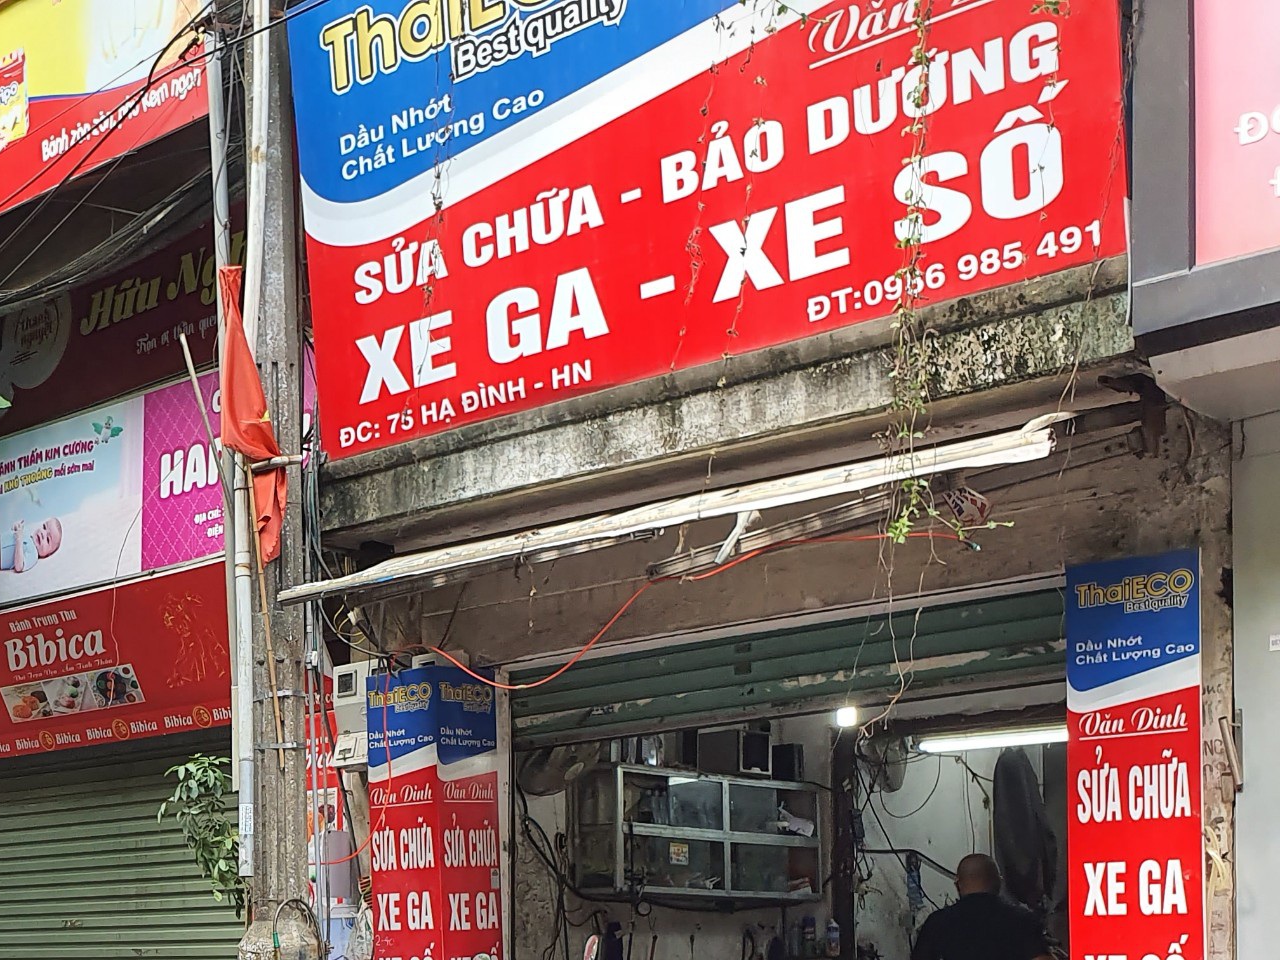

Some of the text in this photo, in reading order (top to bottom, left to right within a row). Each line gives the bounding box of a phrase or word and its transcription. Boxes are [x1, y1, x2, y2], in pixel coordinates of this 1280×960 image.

[454, 35, 519, 77] Best
[141, 82, 169, 113] kem
[170, 68, 202, 100] ngon
[338, 93, 452, 157] Dầu Nhớt
[341, 89, 546, 182] Chất Lượng Cao
[354, 22, 1060, 305] SỬA CHỮA BẢO DƯỠNG
[355, 79, 1070, 405] XE GA XE SỐ
[957, 241, 1023, 281] 985
[1036, 219, 1101, 258] 491
[339, 359, 593, 448] ĐC: 75 HẠ ĐÌNH HN
[45, 446, 61, 461] KIM
[1075, 568, 1194, 608] ThaiECO
[1125, 594, 1188, 613] Best quality
[32, 613, 59, 628] Trung
[59, 609, 77, 622] Thu
[4, 628, 107, 672] Bibica
[1075, 643, 1195, 665] Chất Lượng Cao
[1076, 635, 1143, 653] Dầu Nhớt
[368, 682, 433, 708] ThaiECO
[15, 737, 40, 750] Bibica
[55, 732, 81, 745] Bibica
[86, 728, 113, 740] Bibica
[129, 720, 158, 734] Bibica
[163, 714, 193, 729] Bibica
[418, 734, 433, 743] Cao
[482, 739, 495, 747] Cao
[1079, 712, 1125, 736] Văn
[1077, 745, 1192, 824] SỬA CHỮA
[372, 813, 435, 872] SỬA CHỮA
[444, 813, 498, 867] SỬA CHỮA
[1083, 859, 1188, 916] XE GA
[377, 891, 434, 931] XE GA
[449, 892, 499, 931] XE GA
